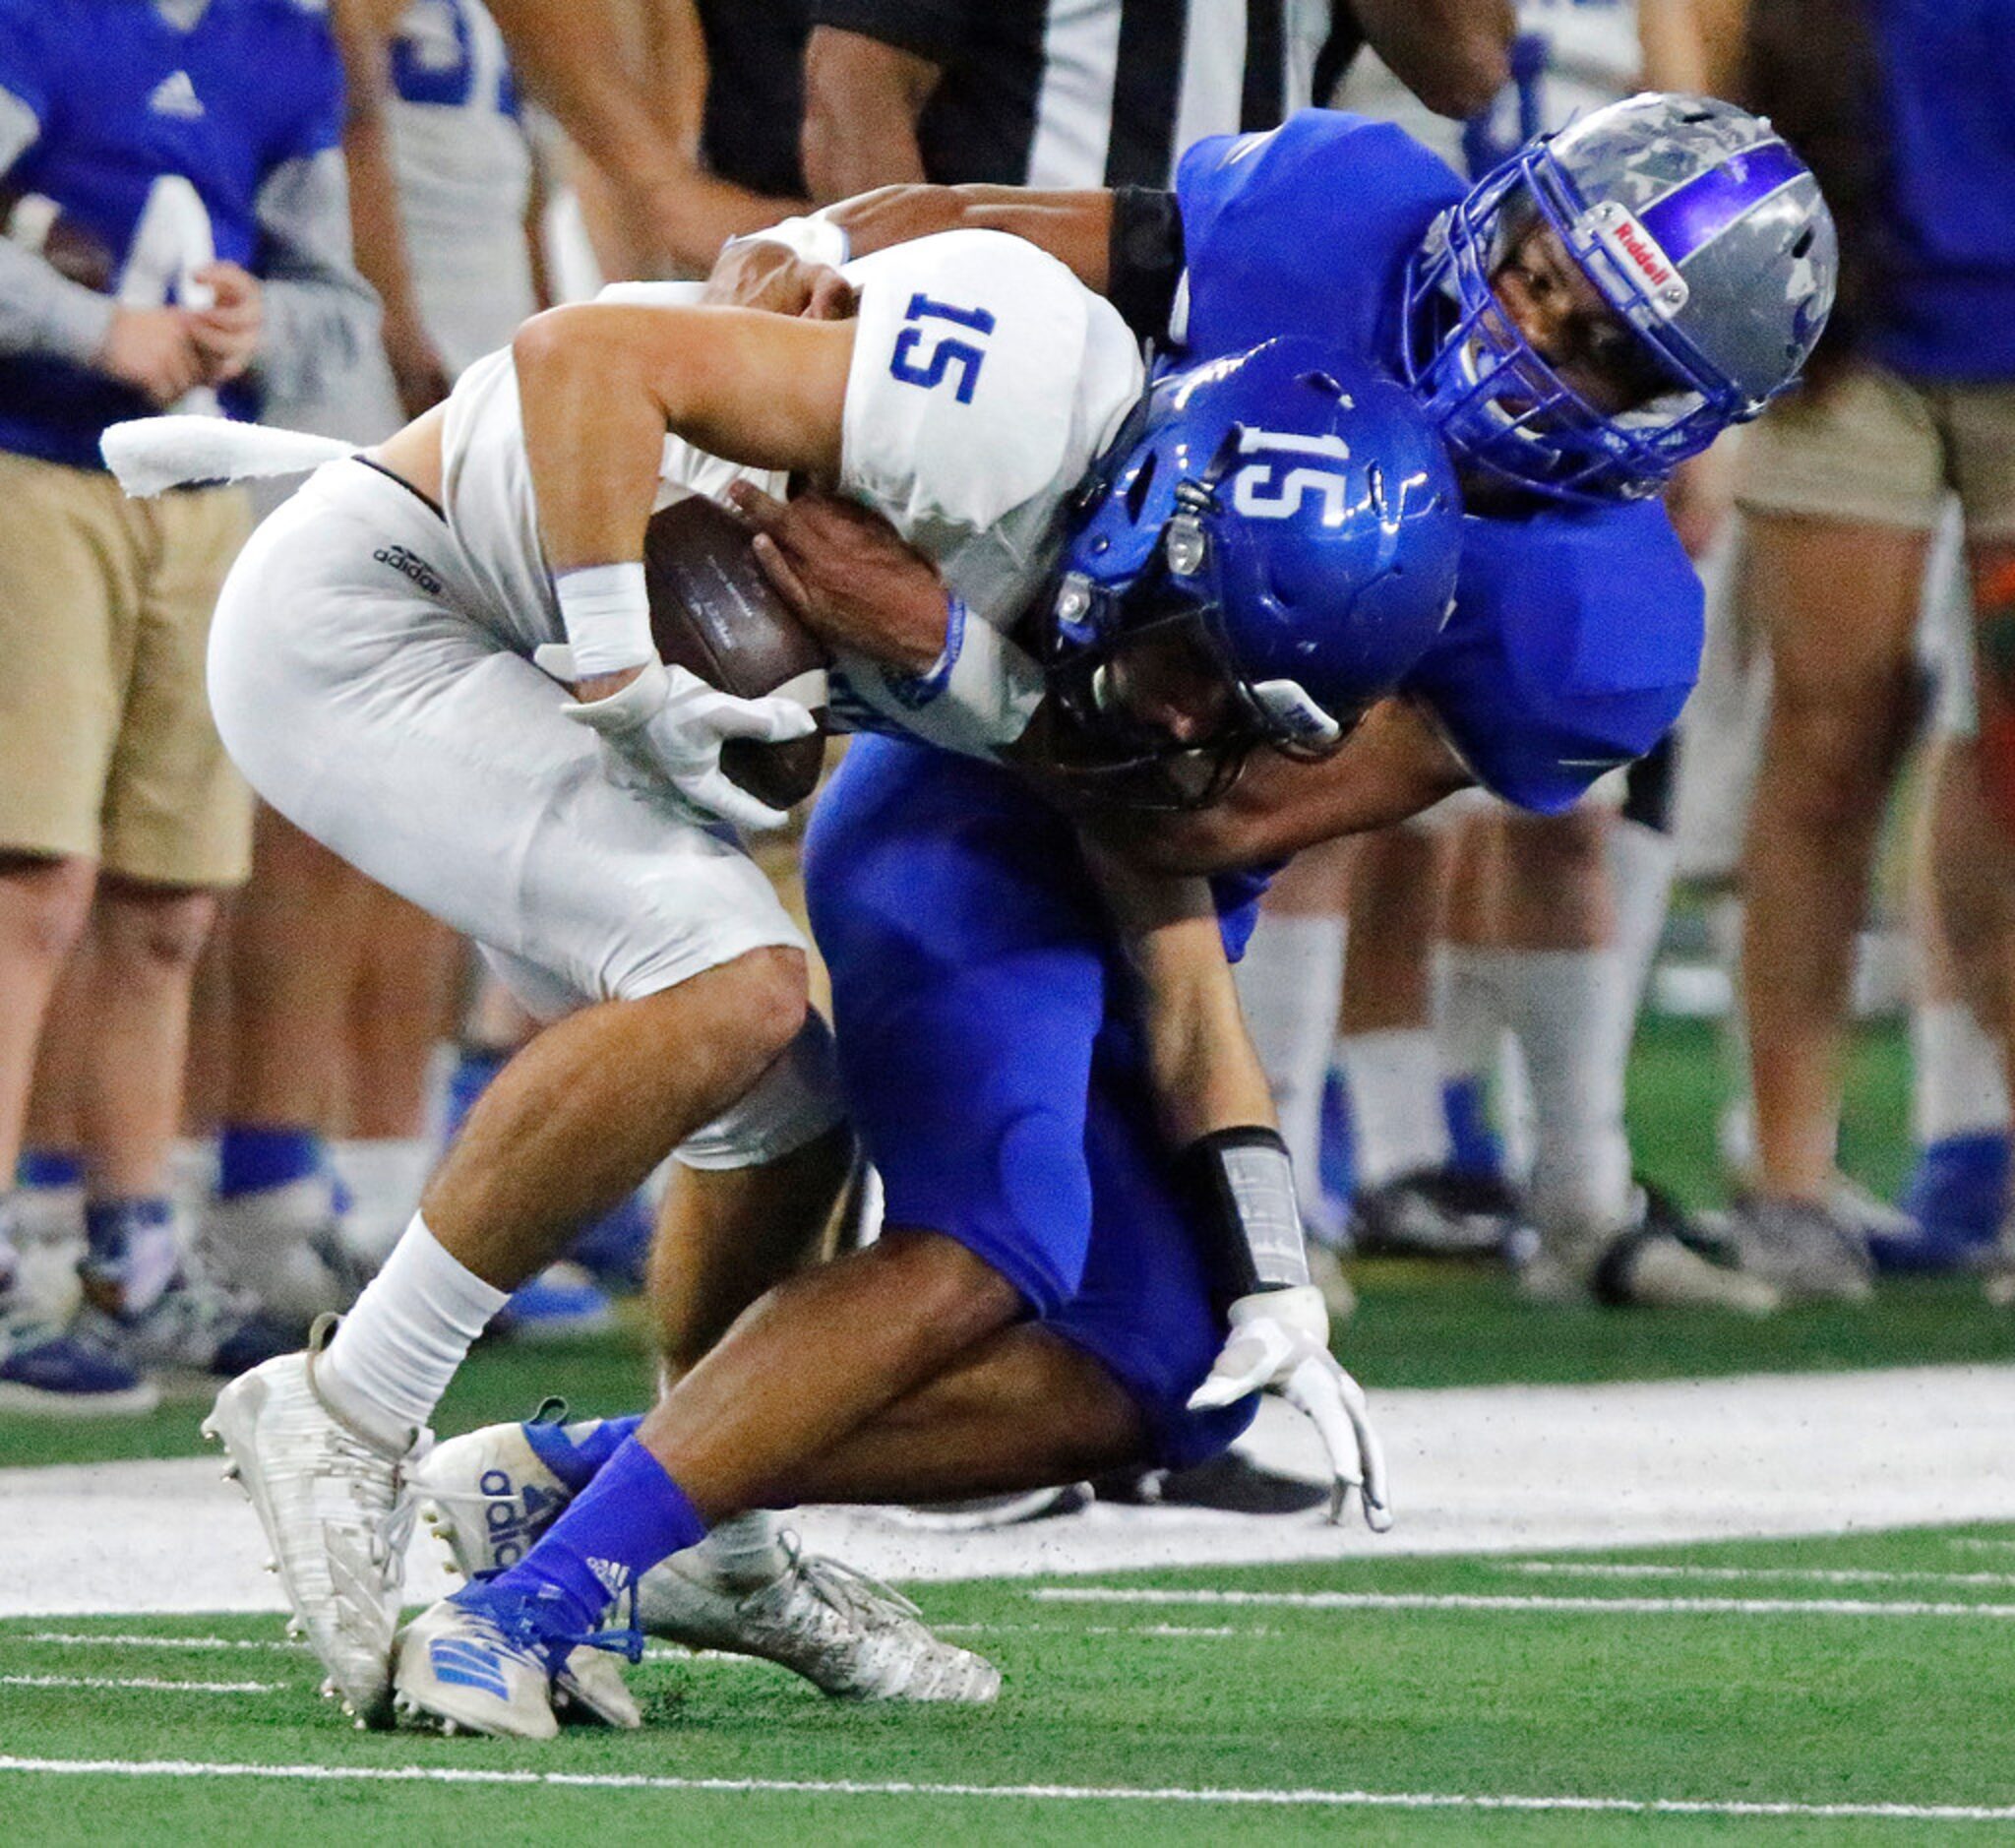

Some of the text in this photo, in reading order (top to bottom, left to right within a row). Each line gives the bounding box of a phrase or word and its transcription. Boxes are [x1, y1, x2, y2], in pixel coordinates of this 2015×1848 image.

[1615, 221, 1670, 285] Riddell
[889, 293, 996, 403] 15
[1234, 427, 1350, 526] 15
